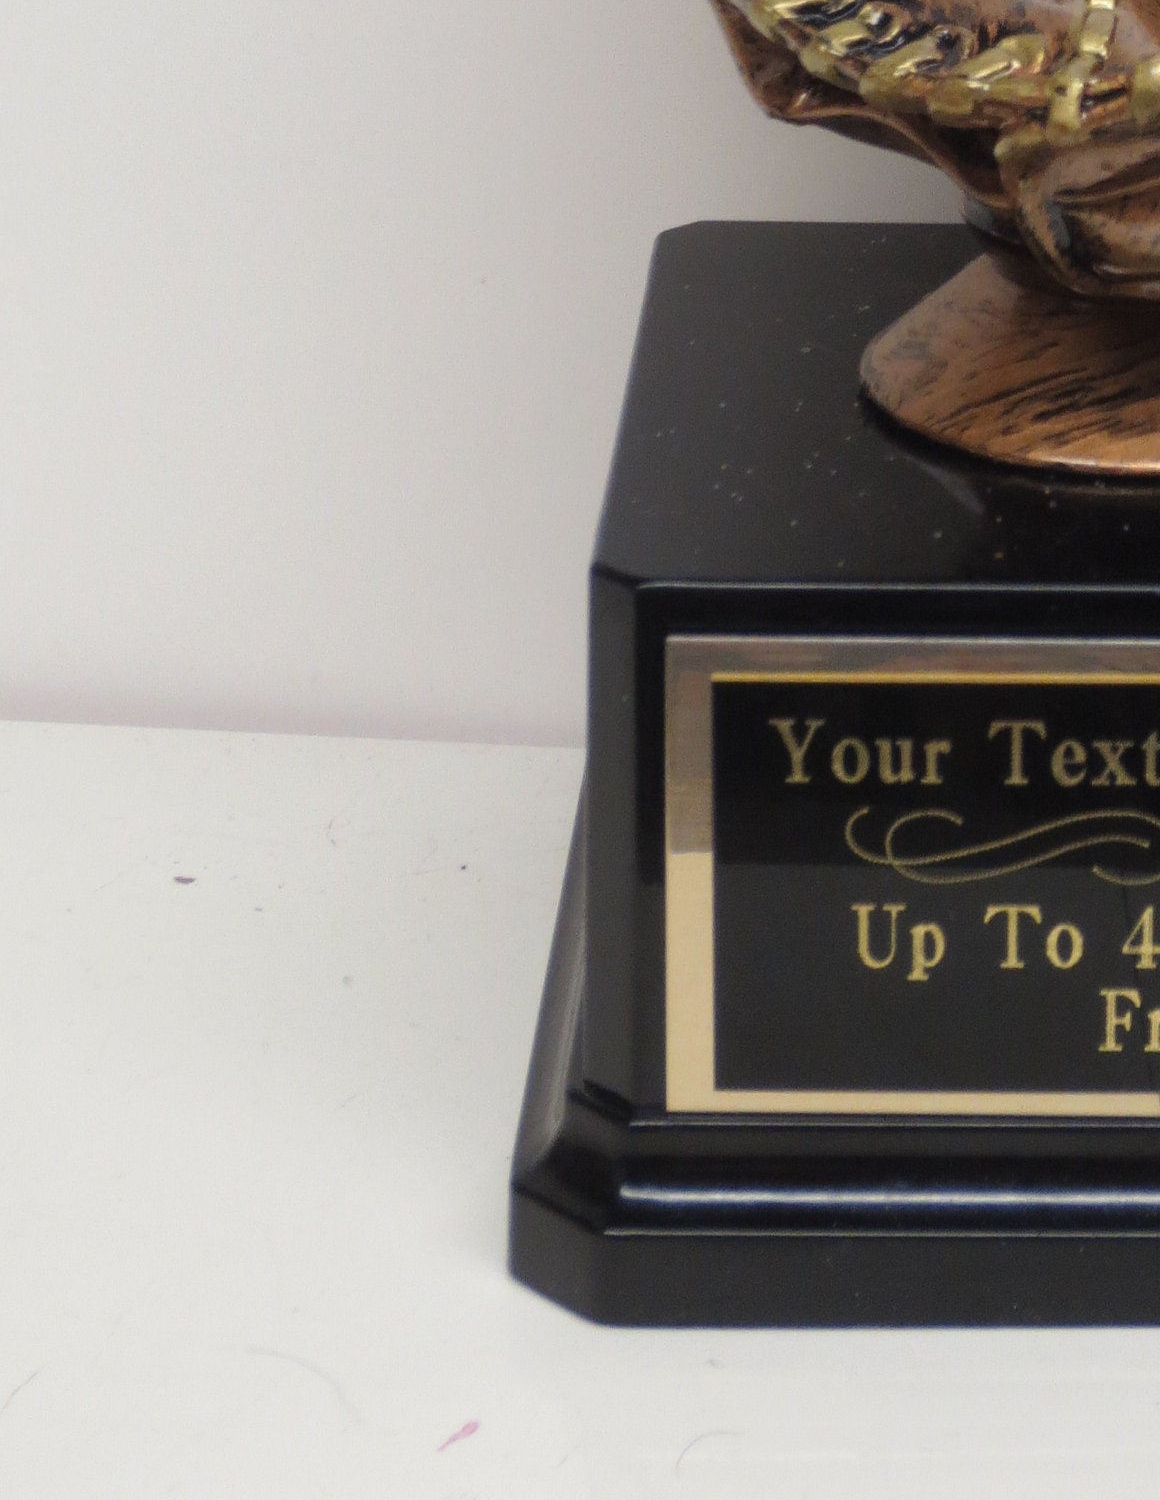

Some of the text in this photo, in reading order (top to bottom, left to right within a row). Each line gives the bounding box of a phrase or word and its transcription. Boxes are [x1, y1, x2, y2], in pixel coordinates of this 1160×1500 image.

[771, 716, 951, 787] Your
[850, 903, 946, 982] Up
[983, 904, 1085, 970] To
